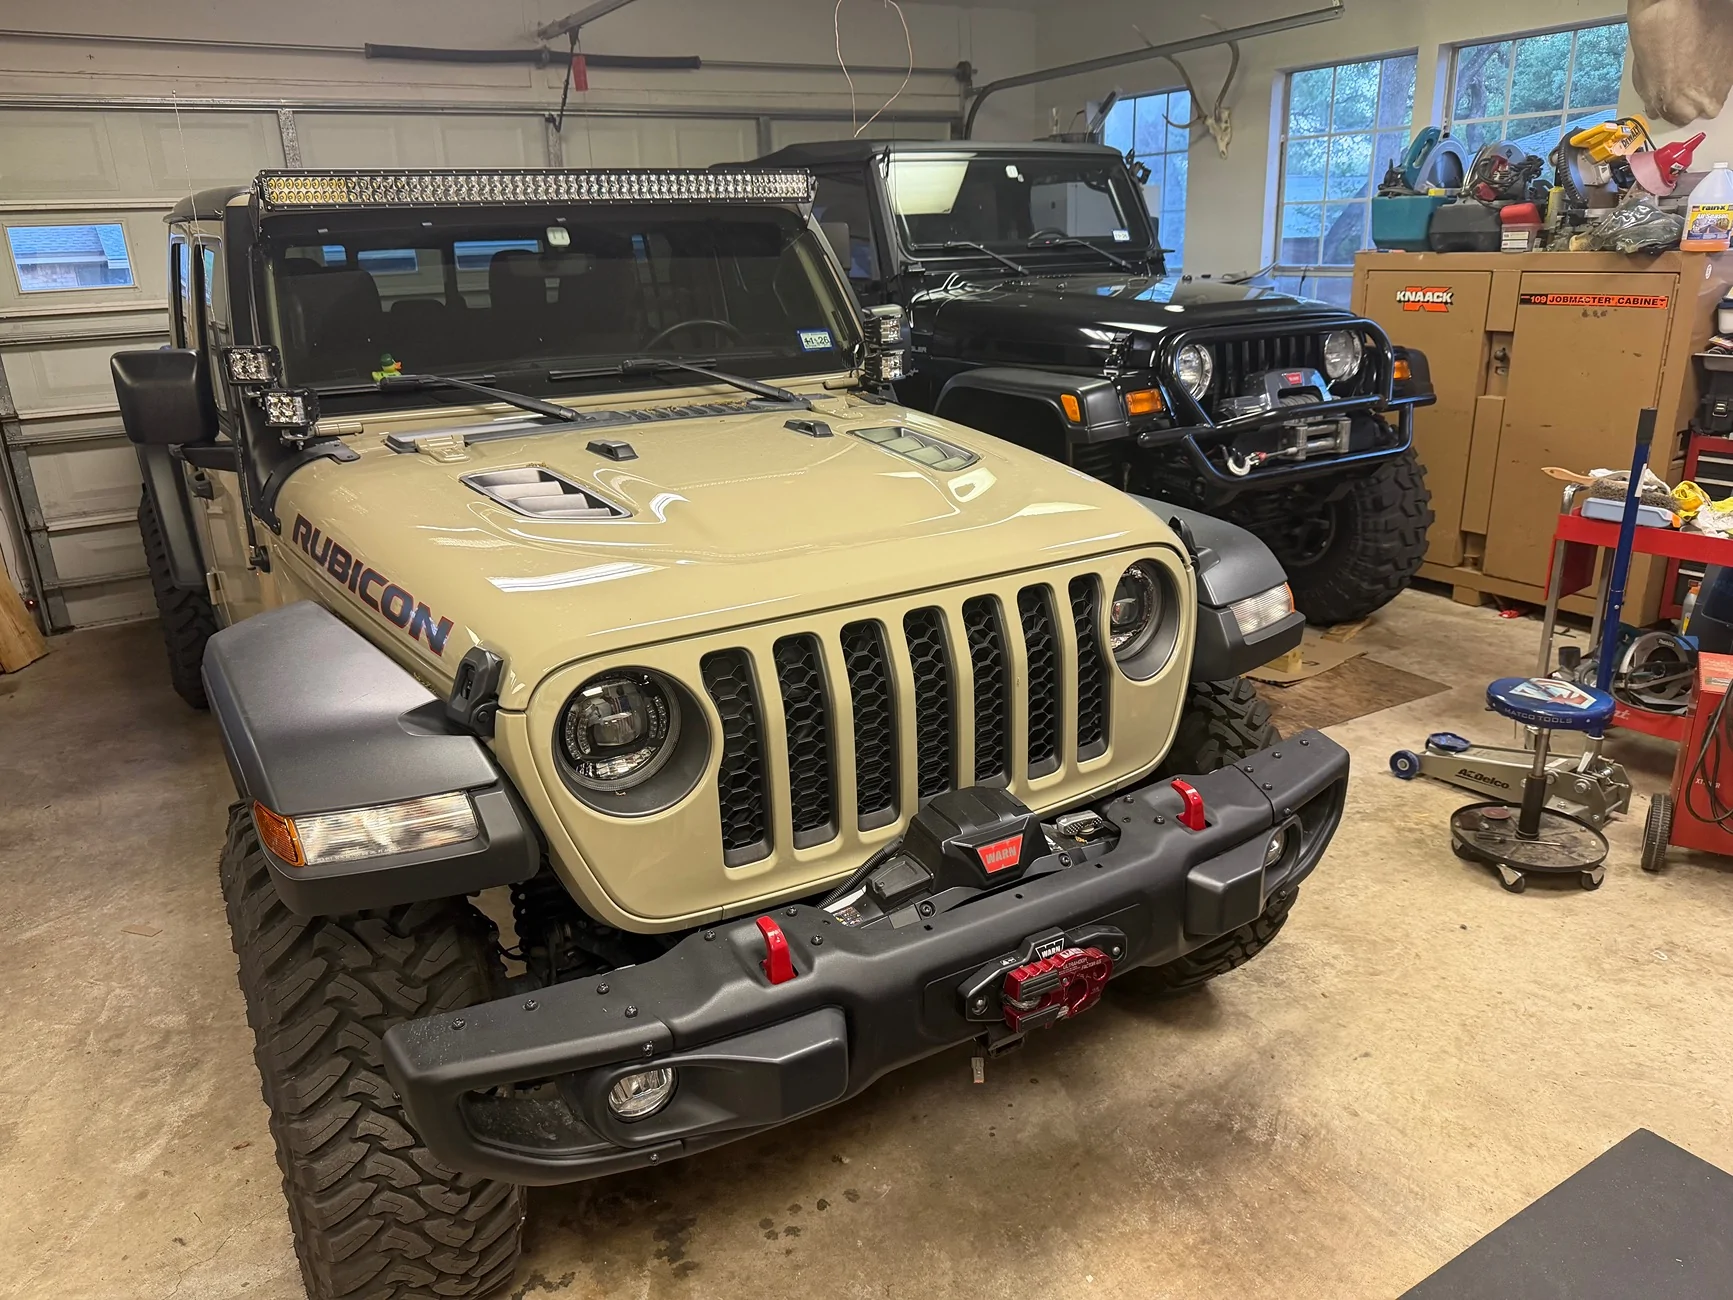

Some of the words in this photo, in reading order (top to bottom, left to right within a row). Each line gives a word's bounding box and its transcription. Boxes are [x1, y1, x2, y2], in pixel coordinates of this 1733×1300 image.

[1396, 290, 1453, 304] KNAACK
[1530, 295, 1547, 304] 109
[292, 513, 454, 657] RUBICON
[1504, 707, 1535, 720] MATCO
[1536, 716, 1573, 724] TOOLS
[1458, 768, 1510, 789] ACDelco
[985, 846, 1017, 865] WARN
[1041, 945, 1061, 958] WARN
